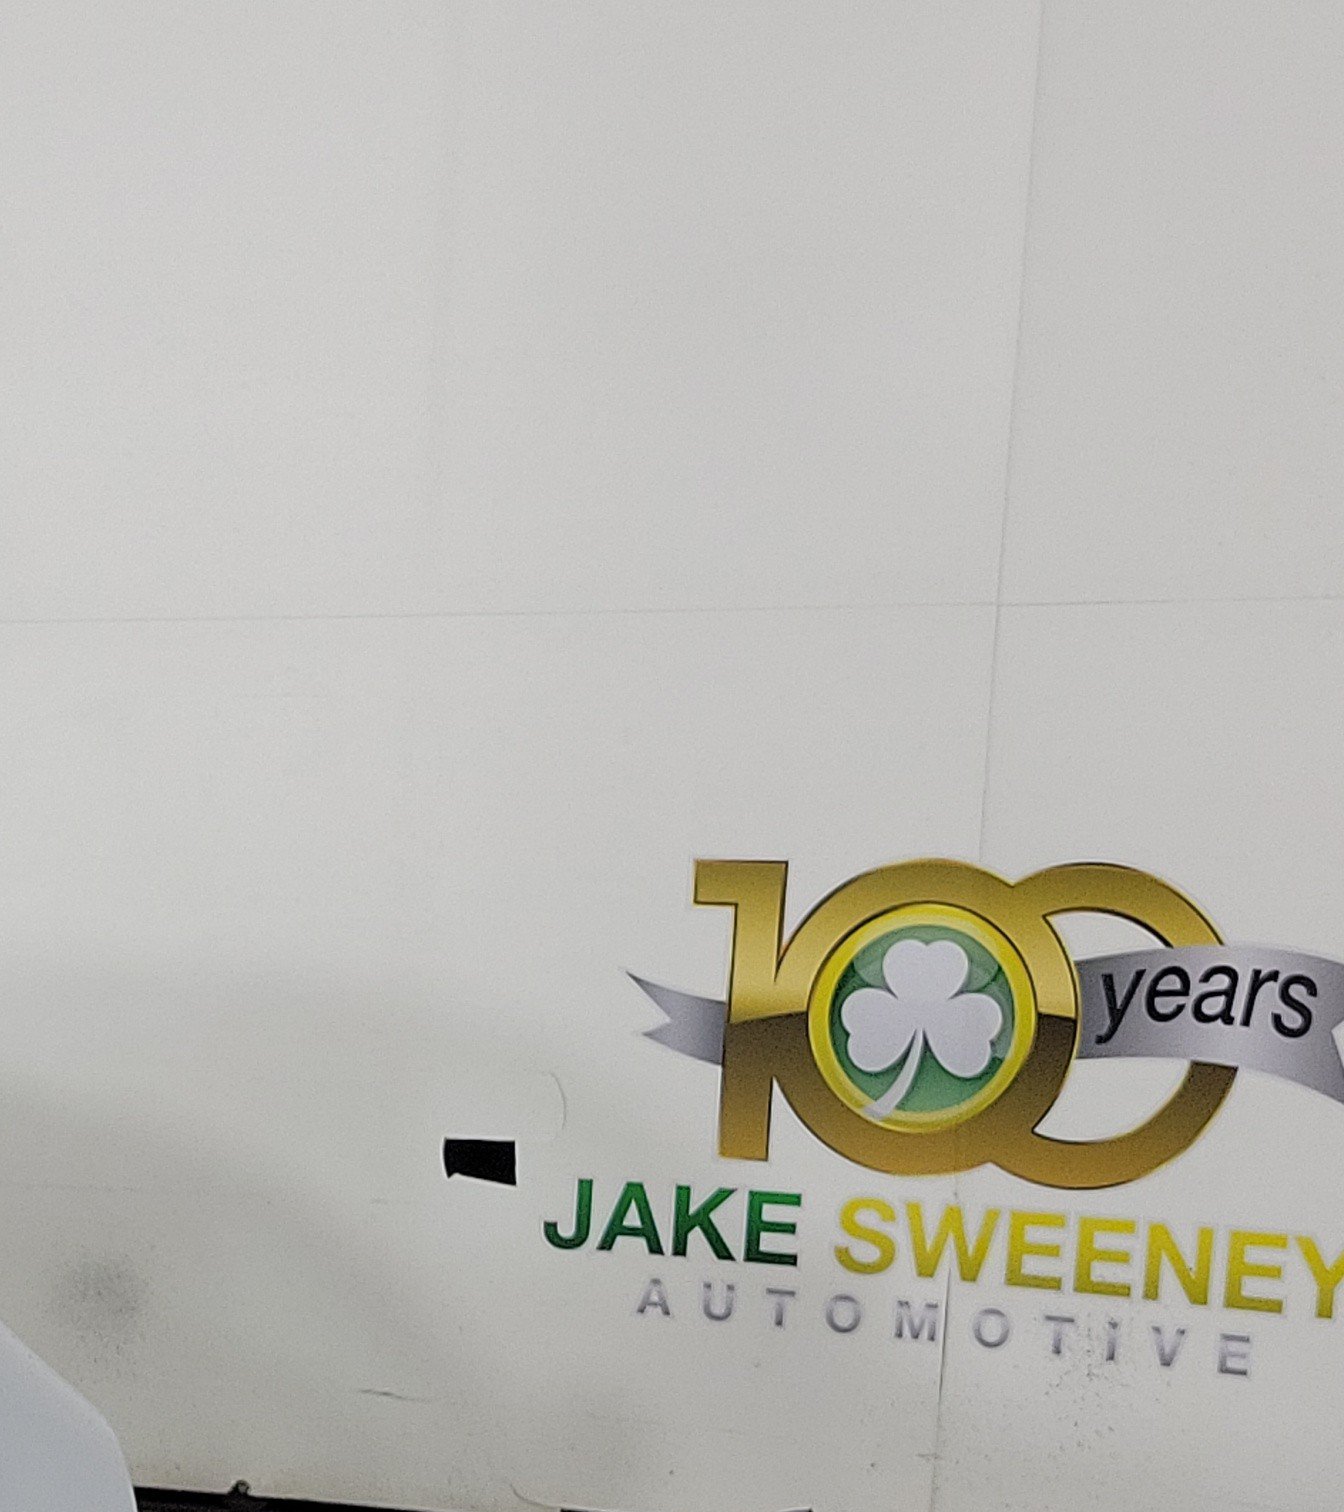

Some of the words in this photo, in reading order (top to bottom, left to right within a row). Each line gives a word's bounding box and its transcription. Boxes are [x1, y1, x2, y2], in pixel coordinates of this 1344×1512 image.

[693, 858, 1239, 1190] 100
[1095, 963, 1319, 1045] years
[543, 1178, 804, 1267] JAKE
[834, 1197, 1344, 1319] SWEENEY
[637, 1278, 1252, 1377] AUTOMOTIVE
